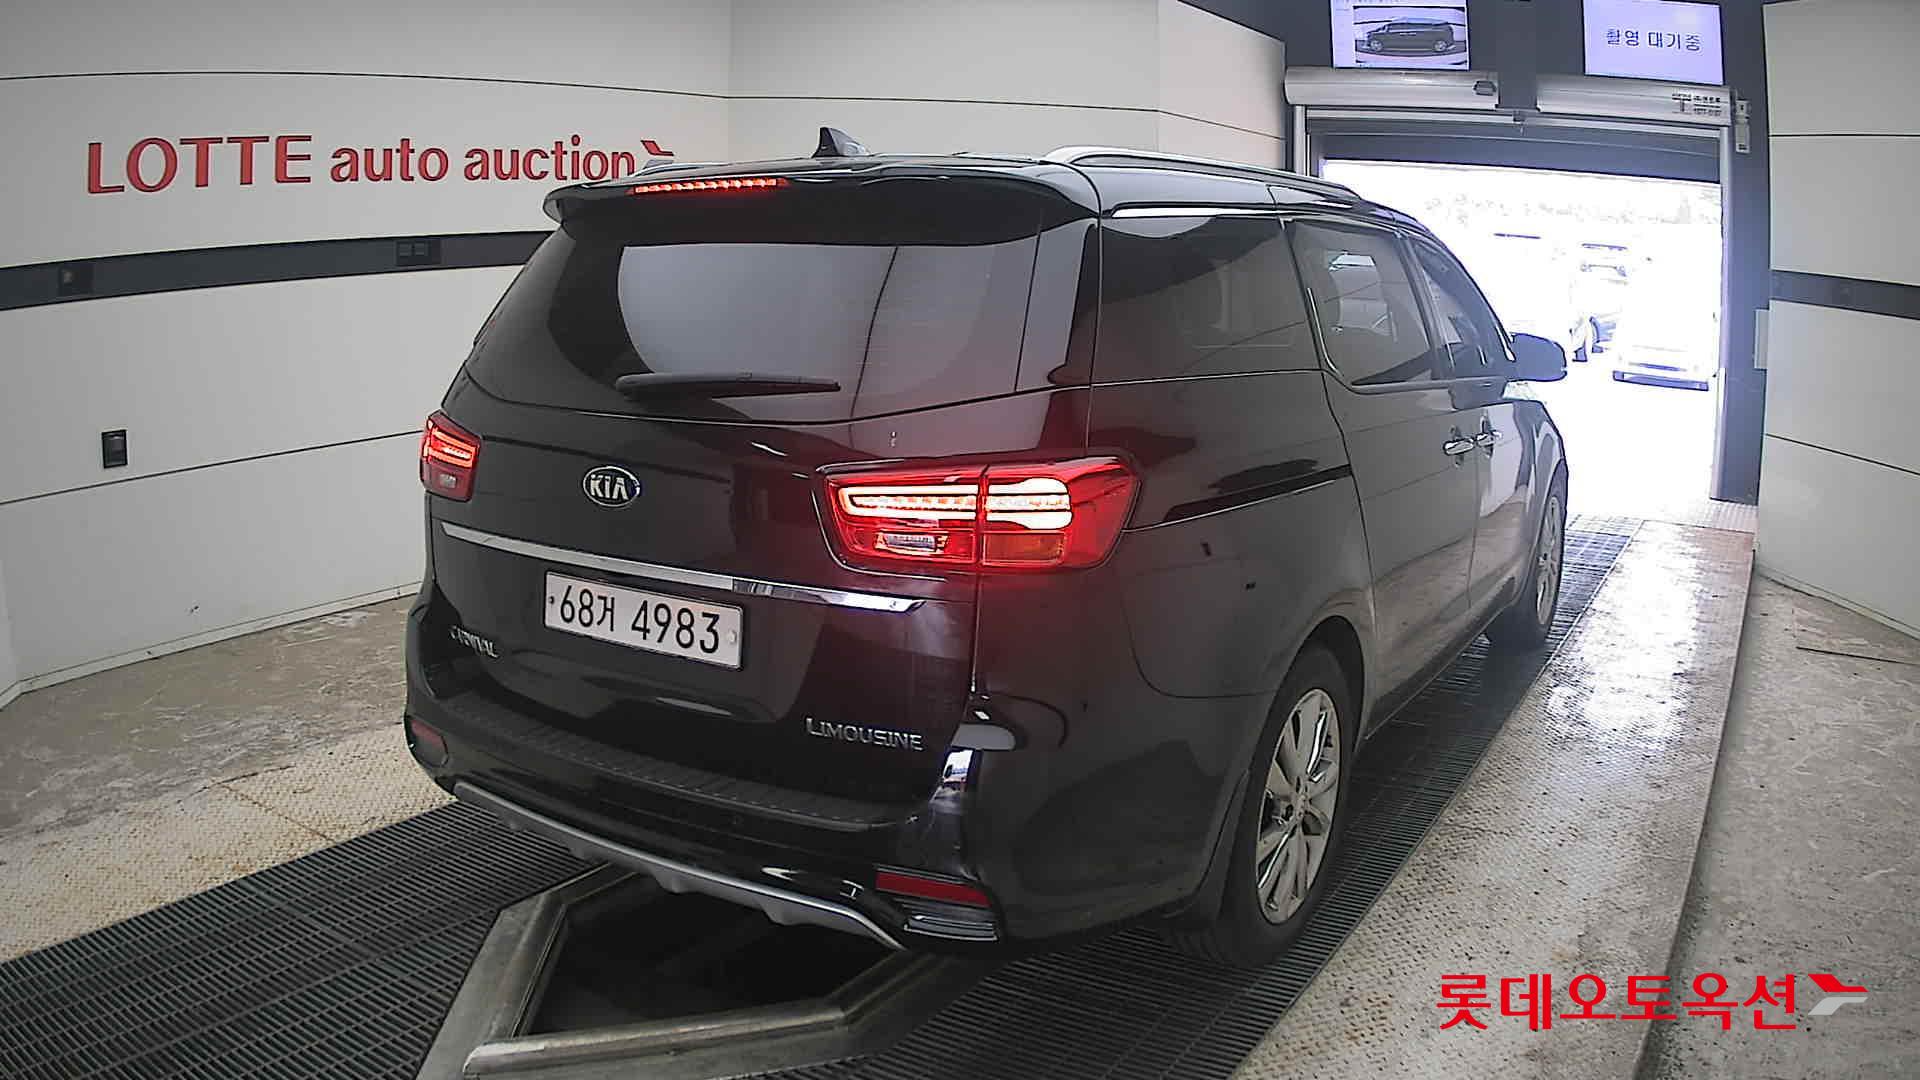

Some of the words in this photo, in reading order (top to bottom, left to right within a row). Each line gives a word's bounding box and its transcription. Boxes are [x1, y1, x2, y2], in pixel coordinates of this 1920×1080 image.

[1647, 31, 1700, 52] 대기중
[87, 135, 312, 194] LOTTE
[329, 138, 449, 182] auto
[463, 134, 635, 182] auction
[590, 474, 629, 501] KIA
[560, 585, 615, 632] 68거
[631, 599, 720, 654] 4983
[805, 717, 924, 751] LIMOUSINE
